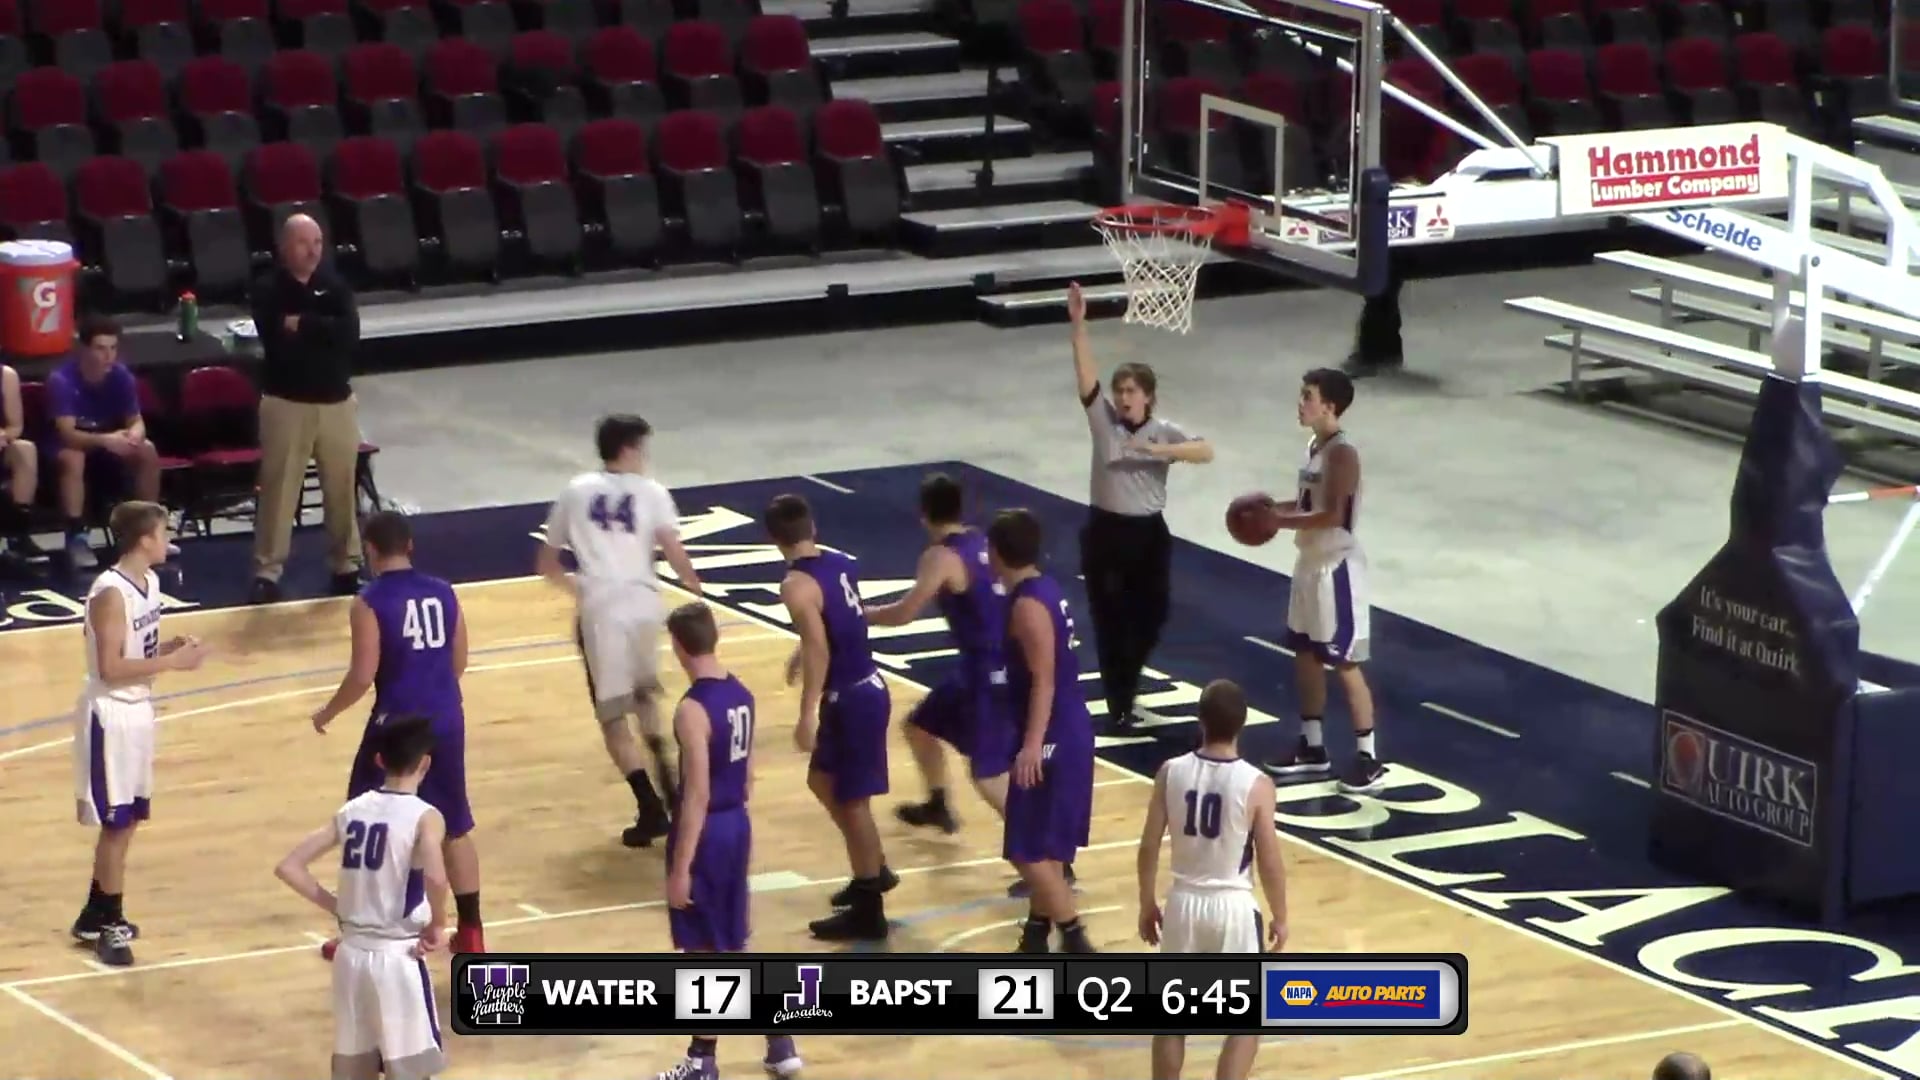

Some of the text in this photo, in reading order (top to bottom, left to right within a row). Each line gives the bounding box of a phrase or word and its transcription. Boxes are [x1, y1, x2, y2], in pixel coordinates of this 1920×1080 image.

[1588, 133, 1760, 177] Hammond
[1592, 173, 1760, 202] Lumber Company
[1665, 206, 1762, 252] Schelde
[34, 281, 57, 309] G
[590, 493, 636, 534] 44
[403, 596, 447, 651] 40
[1700, 585, 1721, 611] It's
[1725, 600, 1758, 625] your
[1692, 614, 1799, 677] Find it at Quirk
[1184, 789, 1222, 839] 10
[1708, 781, 1809, 836] AUTO GROUP
[342, 819, 389, 871] 20
